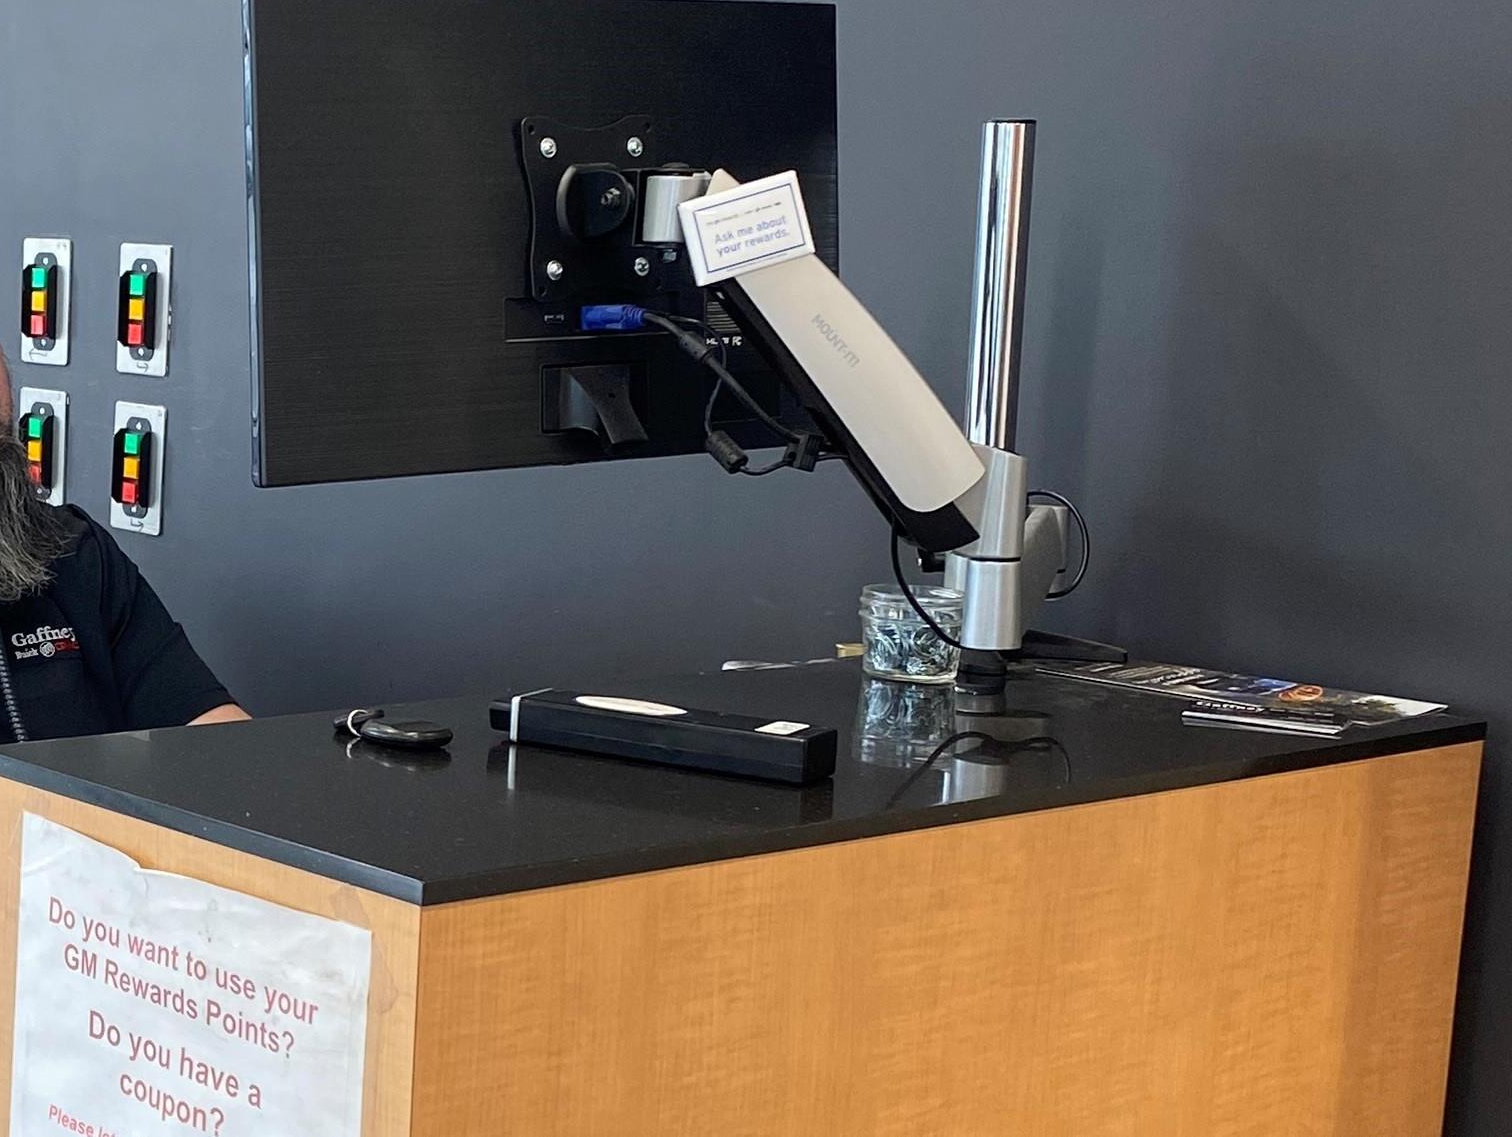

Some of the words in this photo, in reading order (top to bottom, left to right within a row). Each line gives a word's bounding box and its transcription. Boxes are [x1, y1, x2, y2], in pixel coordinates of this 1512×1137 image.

[715, 231, 734, 243] Ask
[737, 226, 753, 237] me
[756, 215, 787, 232] about
[716, 242, 742, 257] your
[11, 626, 76, 647] Gaffney
[49, 896, 75, 929] Do
[82, 914, 120, 948] you
[128, 931, 179, 971] want
[185, 951, 207, 981] to
[215, 969, 256, 1000] use
[263, 985, 319, 1025] your
[63, 943, 97, 979] GM
[104, 959, 198, 1019] Rewards
[206, 1000, 295, 1058] Points?
[89, 1010, 121, 1046] Do
[128, 1031, 170, 1070] you
[180, 1047, 239, 1098] have
[248, 1081, 262, 1109] a
[48, 1103, 94, 1137] Please
[119, 1072, 225, 1136] coupon?
